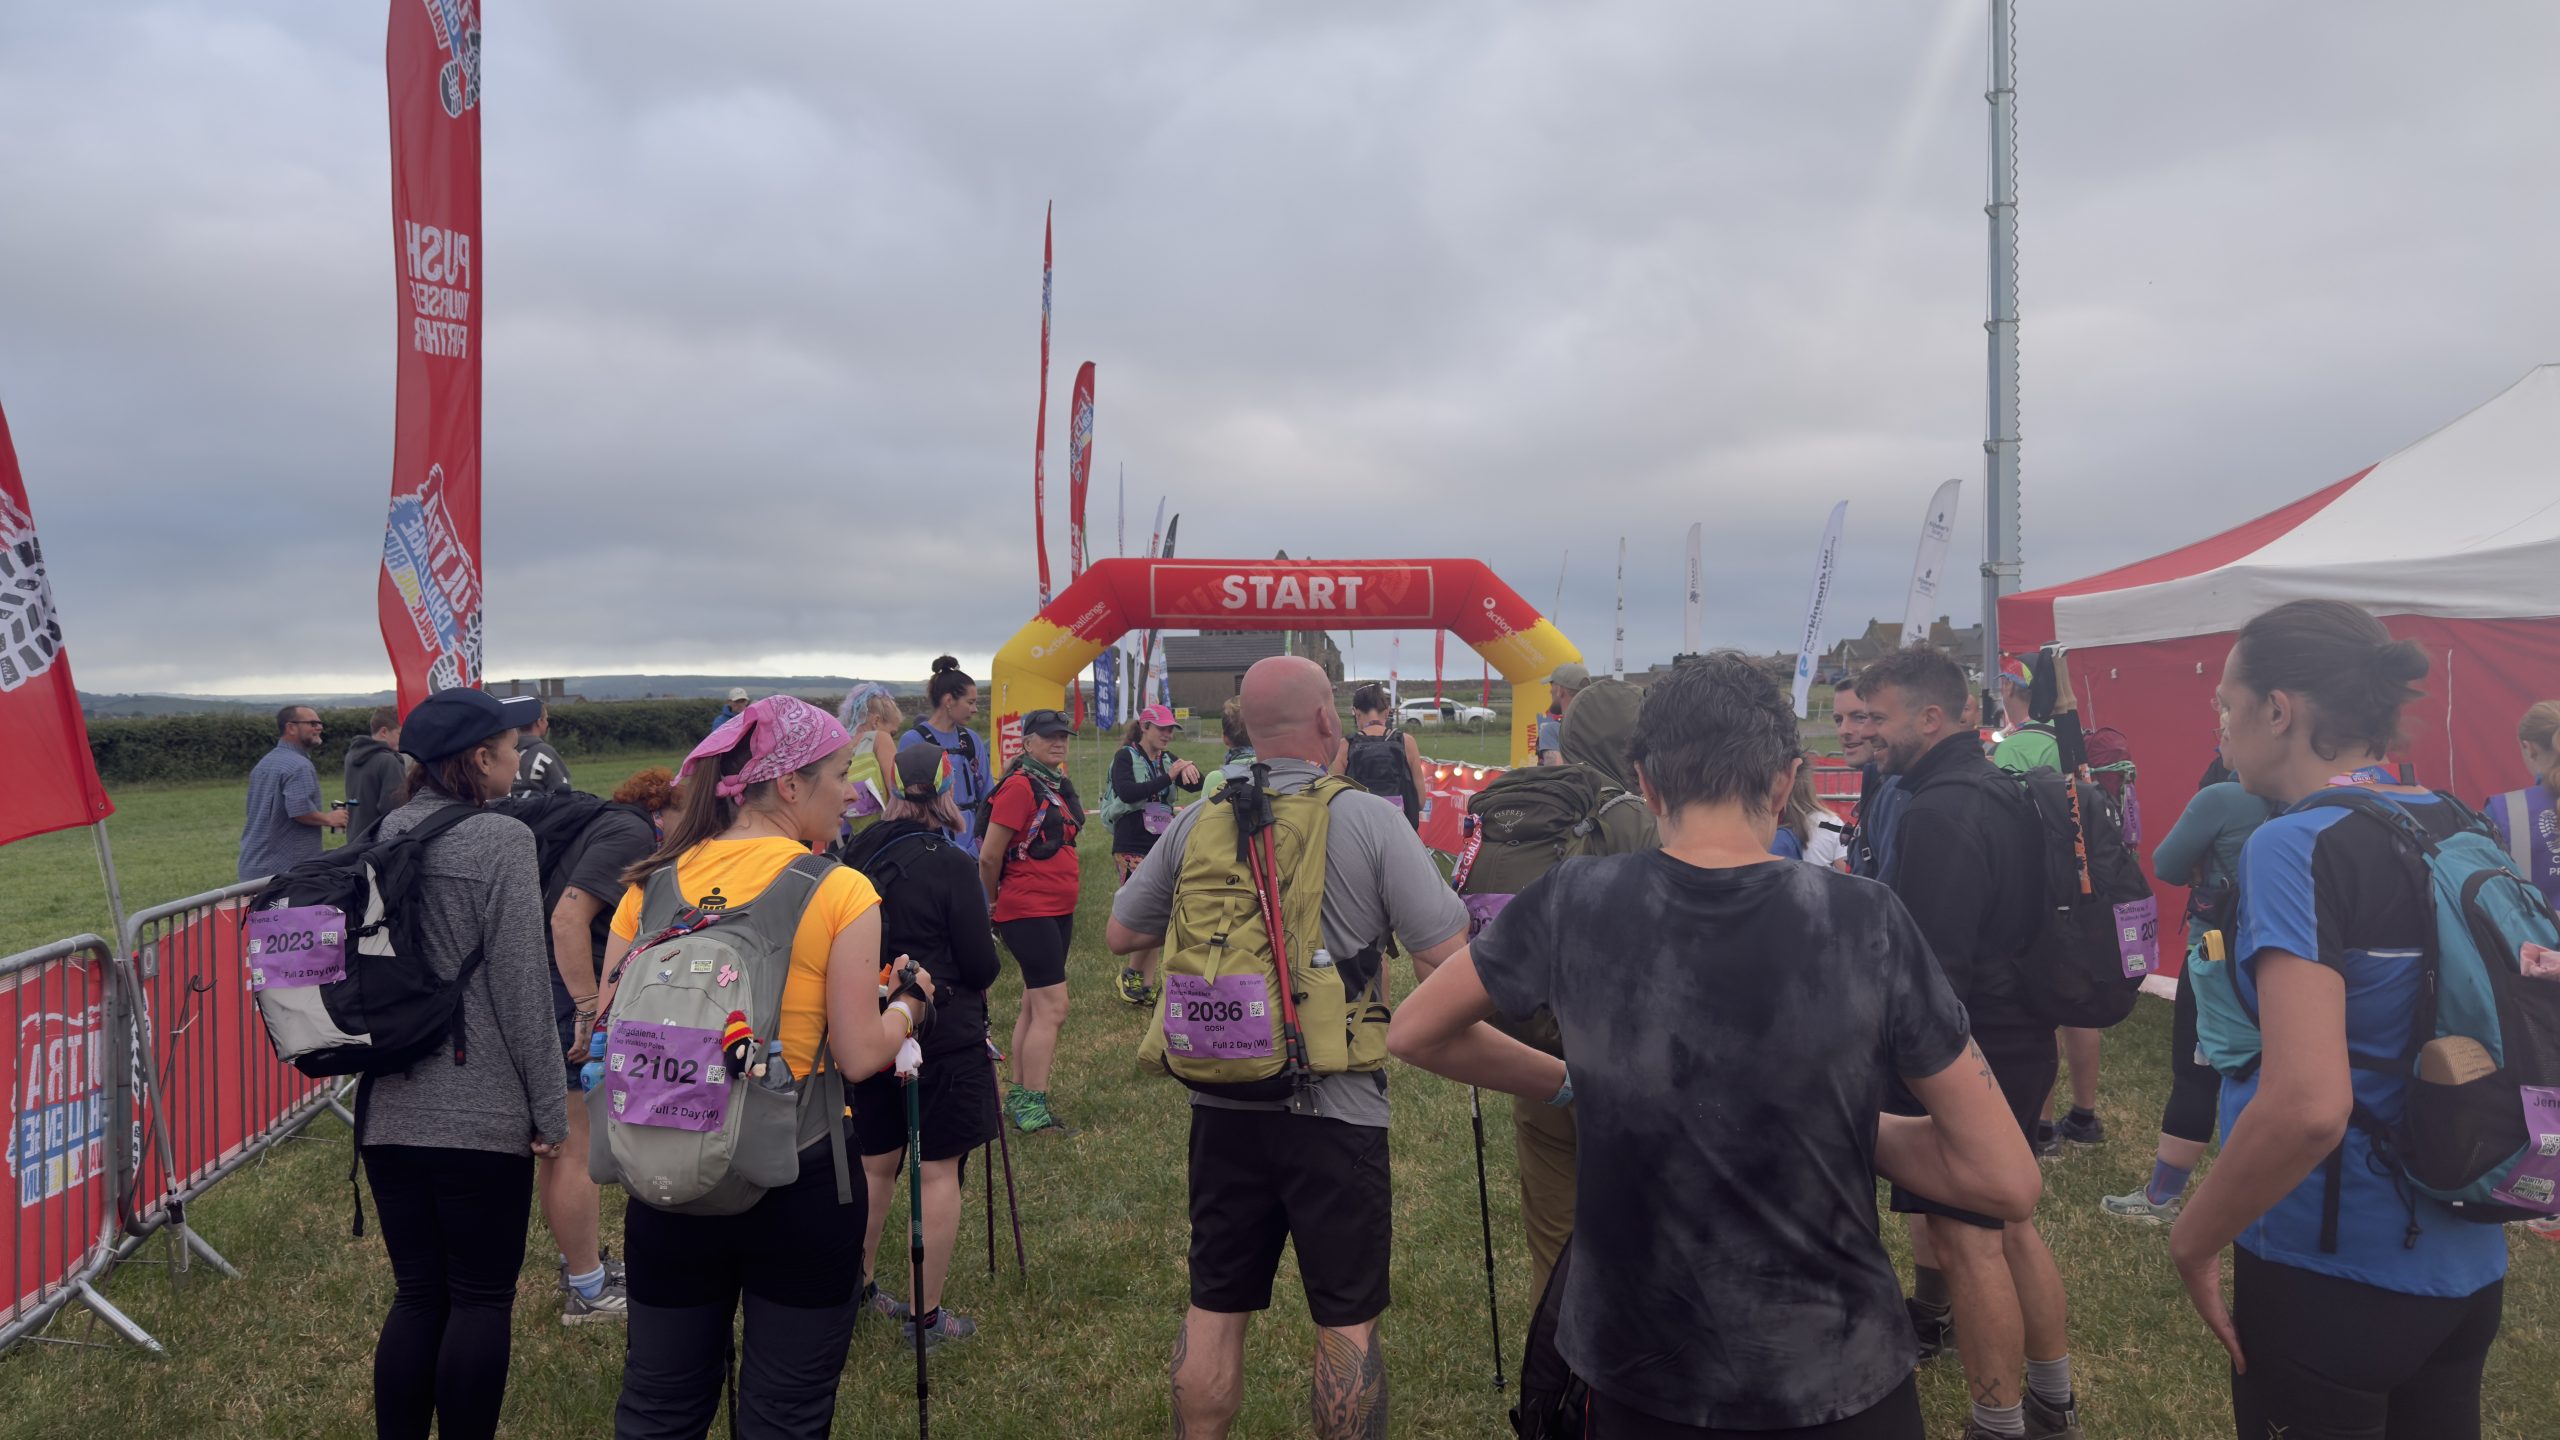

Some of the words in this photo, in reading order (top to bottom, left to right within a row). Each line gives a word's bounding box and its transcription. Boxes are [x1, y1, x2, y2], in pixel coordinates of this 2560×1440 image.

[1222, 575, 1363, 609] START
[1495, 810, 1526, 819] OSPREY
[265, 931, 314, 954] 2023
[298, 970, 305, 978] 2
[306, 968, 325, 977] Day
[1187, 1001, 1243, 1021] 2036
[1212, 1041, 1228, 1049] Full
[1229, 1041, 1235, 1049] 2
[1236, 1041, 1253, 1050] Day
[1254, 1039, 1268, 1049] (W)
[628, 1053, 699, 1084] 2102
[650, 1104, 669, 1115] Full
[671, 1106, 678, 1116] 2
[681, 1108, 701, 1120] Day
[702, 1109, 719, 1120] (W)
